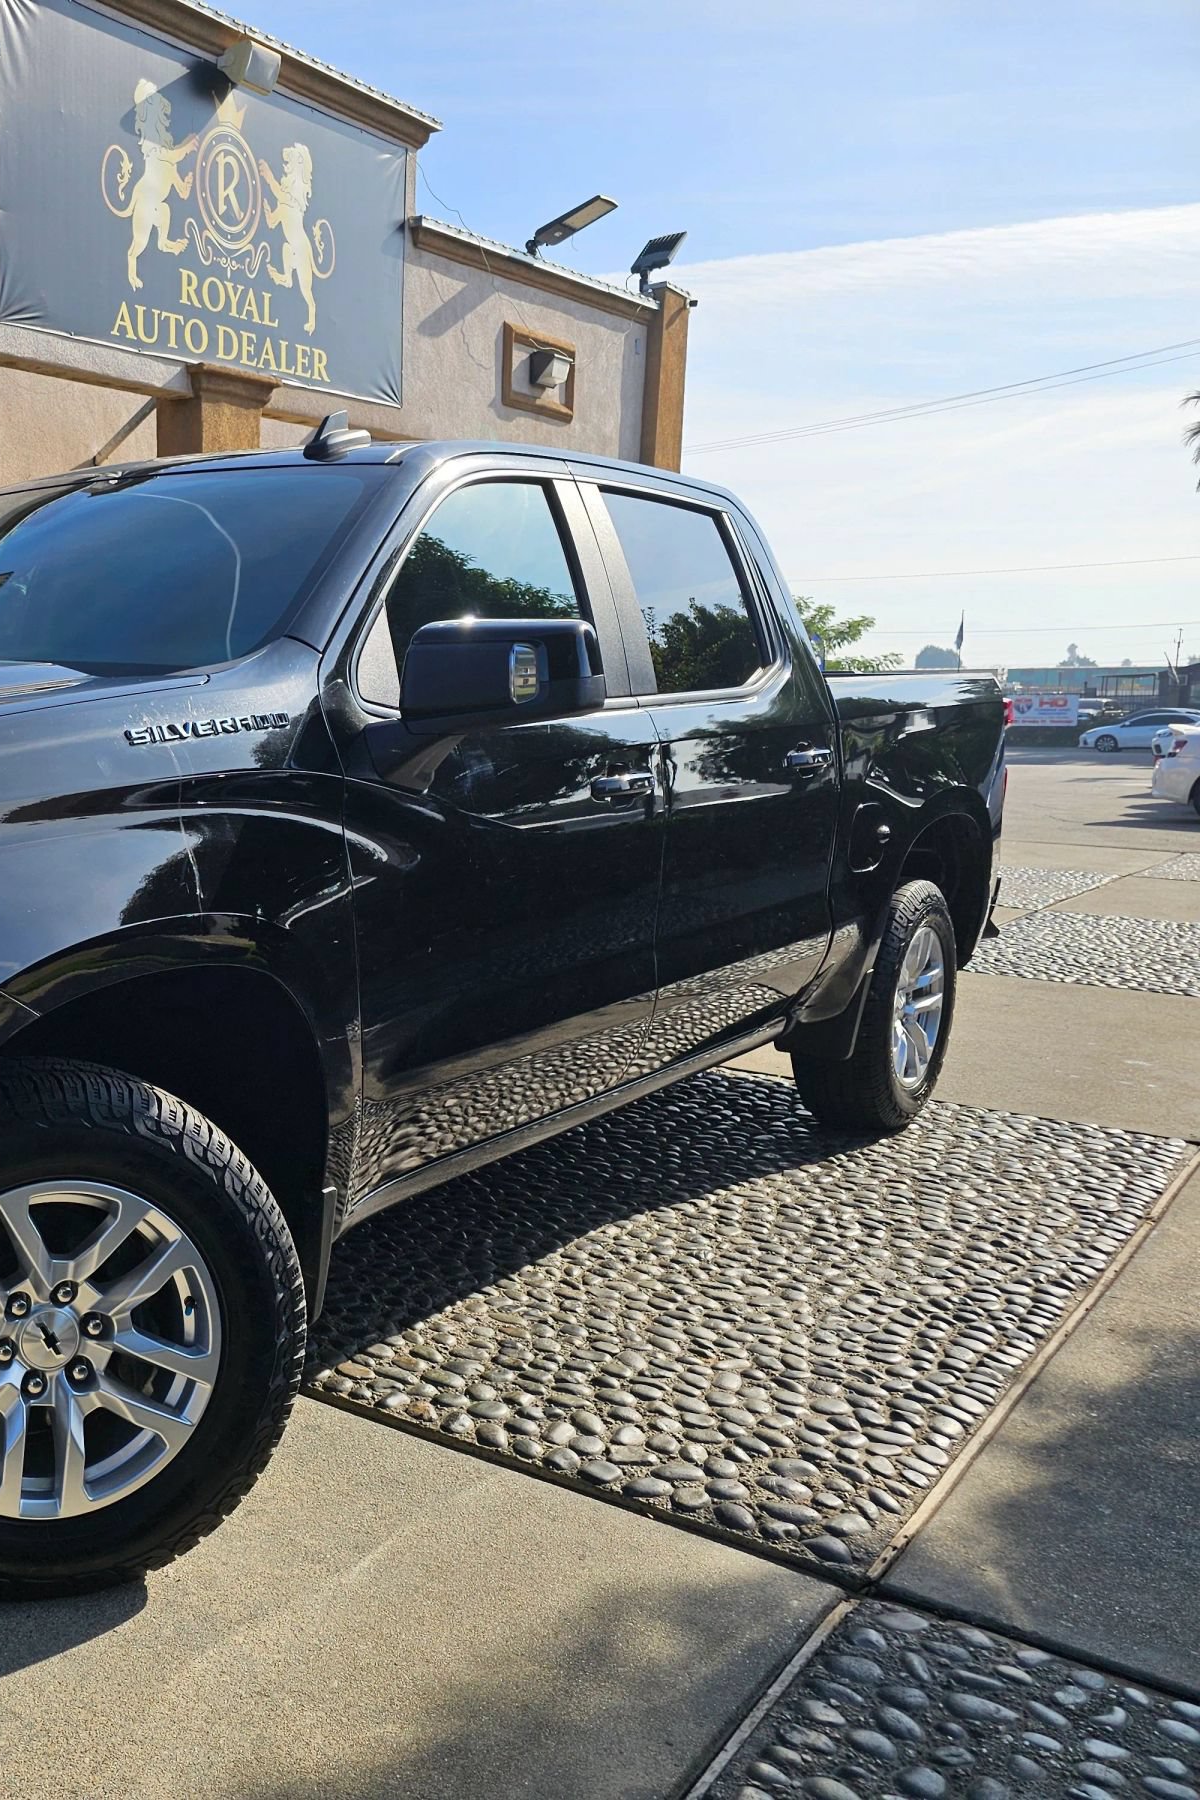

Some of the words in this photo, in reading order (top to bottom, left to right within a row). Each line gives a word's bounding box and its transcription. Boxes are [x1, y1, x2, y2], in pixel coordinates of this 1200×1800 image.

[215, 150, 245, 222] R
[178, 267, 279, 328] ROYAL
[110, 300, 209, 354] AUTO
[215, 323, 331, 382] DEALER
[124, 711, 290, 746] SILVERADO
